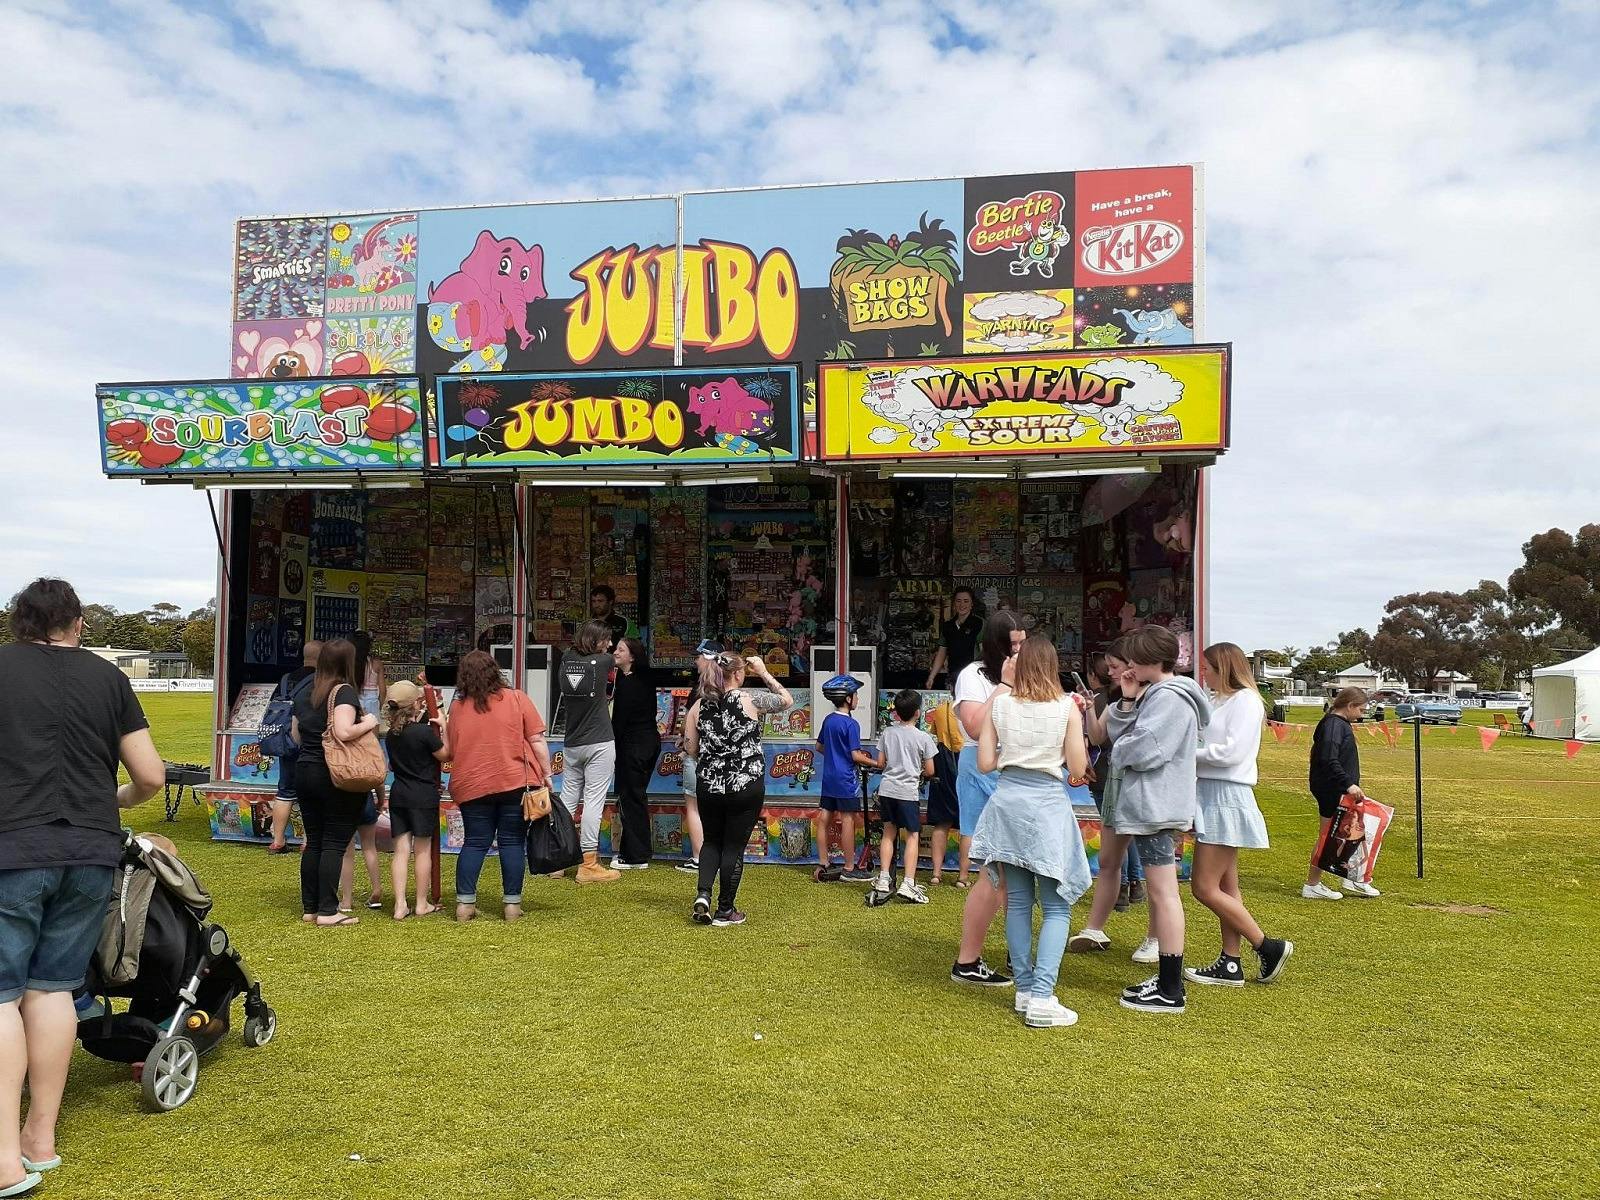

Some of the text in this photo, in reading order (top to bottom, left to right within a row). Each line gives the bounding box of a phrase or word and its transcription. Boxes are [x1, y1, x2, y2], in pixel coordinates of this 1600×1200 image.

[982, 194, 1053, 227] Bertie
[1091, 188, 1172, 212] Have a break,
[1115, 203, 1154, 217] have a
[975, 223, 1024, 246] Beetle
[1097, 223, 1174, 271] KitKat
[849, 276, 932, 302] SHOW
[327, 297, 376, 313] PRETTY
[381, 295, 415, 311] PONY
[565, 238, 797, 365] JUMBO
[854, 297, 929, 323] BAGS
[328, 327, 412, 350] SOURBLAST
[976, 320, 1055, 340] WARNING
[911, 366, 1135, 409] WARHEADS
[151, 405, 369, 447] SOURBLAST
[502, 397, 684, 450] JUMBO
[963, 414, 1077, 430] EXTREME
[968, 426, 1071, 445] SOUR
[313, 501, 363, 524] BONANZA
[895, 580, 943, 593] ARMY
[776, 751, 809, 766] Bertie
